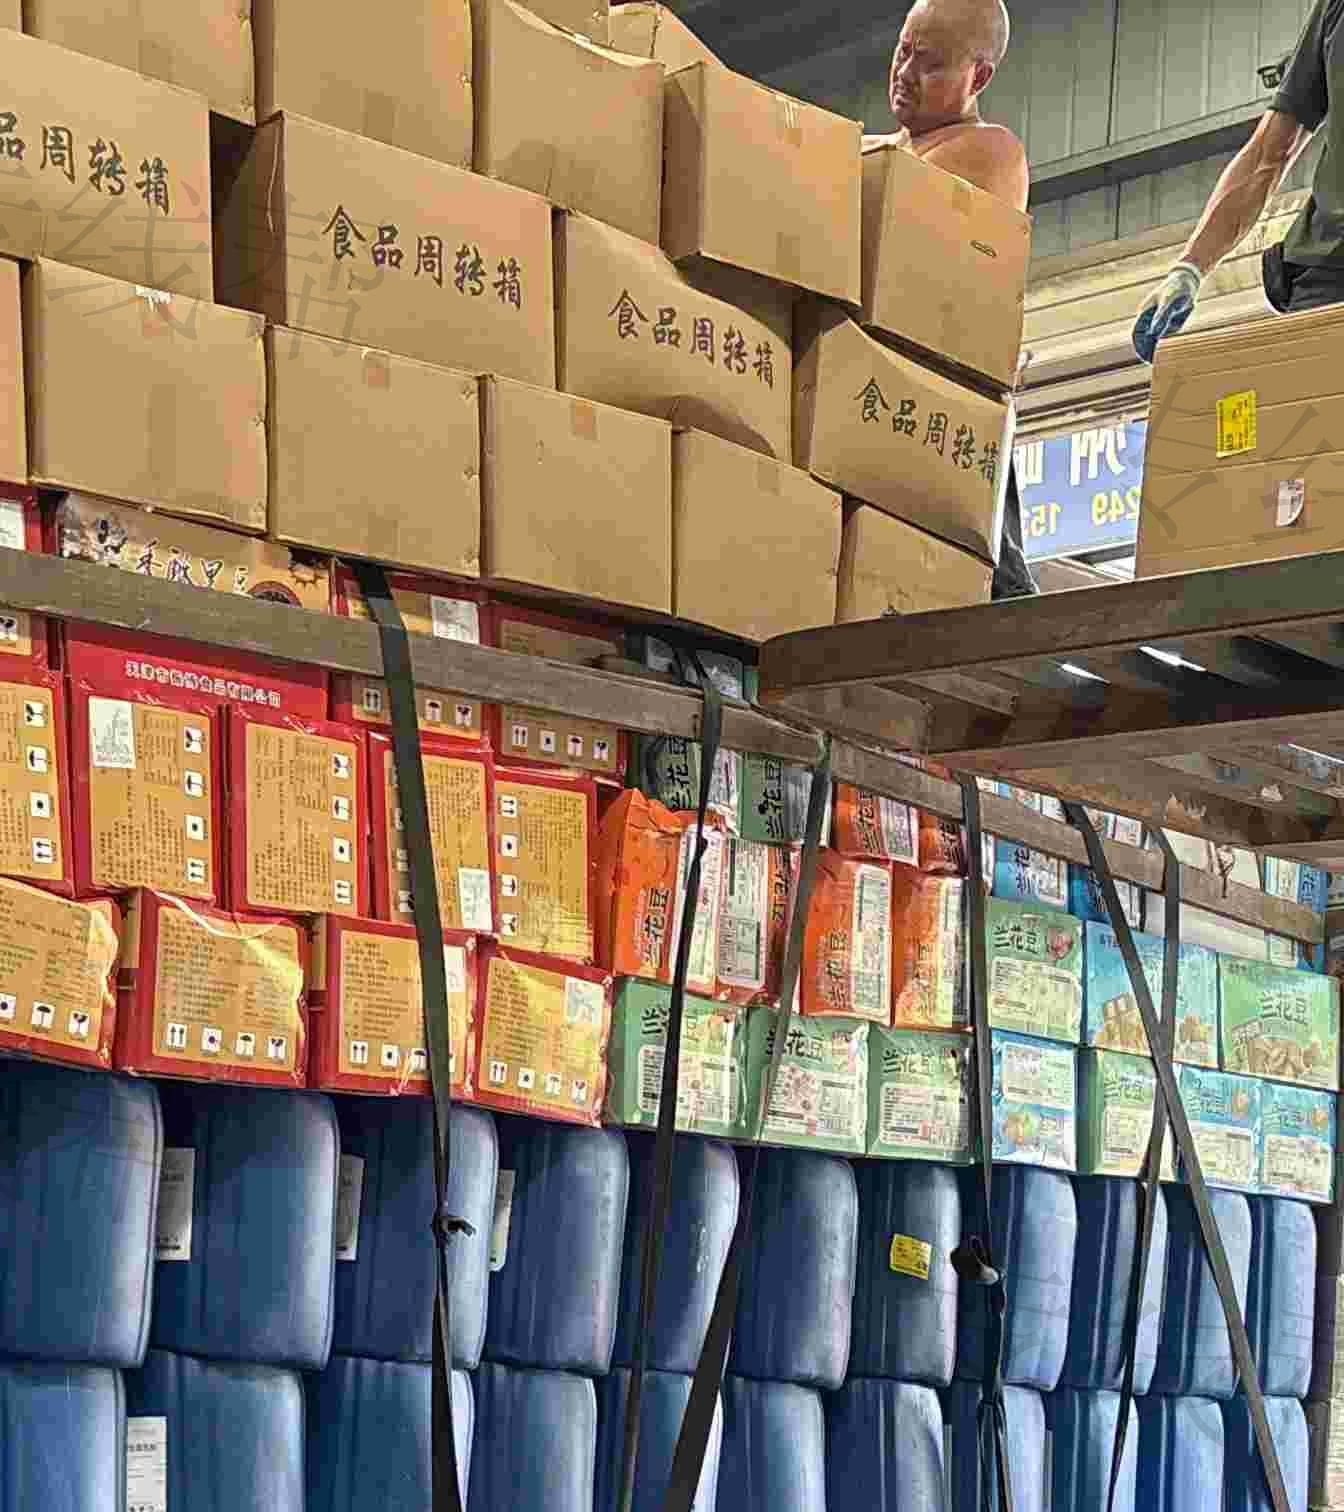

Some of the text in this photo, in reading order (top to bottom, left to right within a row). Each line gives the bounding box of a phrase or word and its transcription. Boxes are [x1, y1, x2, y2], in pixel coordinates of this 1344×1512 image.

[323, 206, 522, 309] 食品周转箱
[609, 289, 777, 391] 食品周转箱
[855, 379, 1000, 481] 食品周转箱
[993, 922, 1042, 954] 兰花豆
[1259, 988, 1308, 1025] 兰花豆
